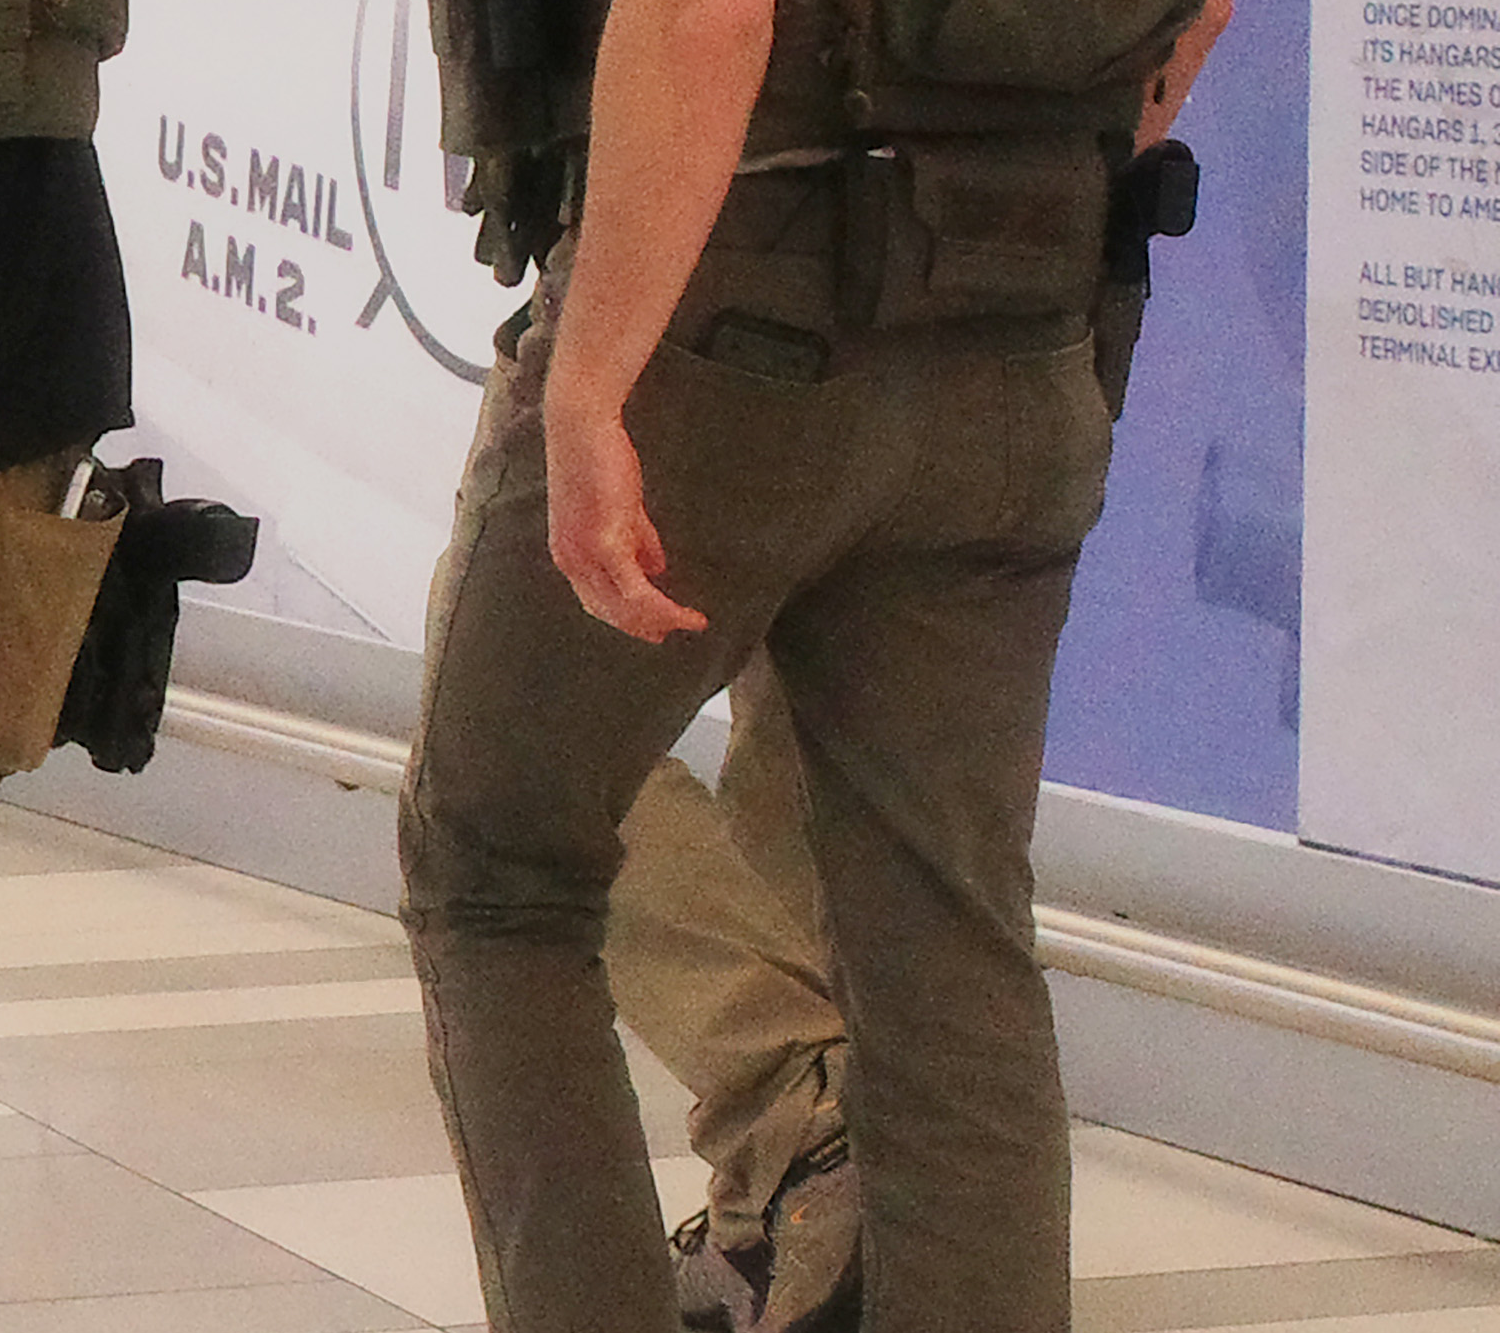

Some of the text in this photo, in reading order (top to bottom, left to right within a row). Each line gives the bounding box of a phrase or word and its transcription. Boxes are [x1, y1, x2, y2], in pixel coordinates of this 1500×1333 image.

[1363, 1, 1500, 33] ONCE DOMIN
[1364, 37, 1500, 70] ITS HANGARS
[1363, 76, 1402, 101] THE
[1408, 79, 1483, 107] NAMES
[1362, 113, 1464, 143] HANGARS
[1361, 150, 1409, 176] SIDE
[1414, 154, 1441, 178] OF
[1447, 157, 1488, 184] THE
[1360, 187, 1420, 215] HOME
[1426, 191, 1453, 218] TO
[1359, 260, 1500, 298] ALL BUT HAN
[1358, 297, 1494, 334] DEMOLISHED
[1358, 334, 1462, 369] TERMINAL
